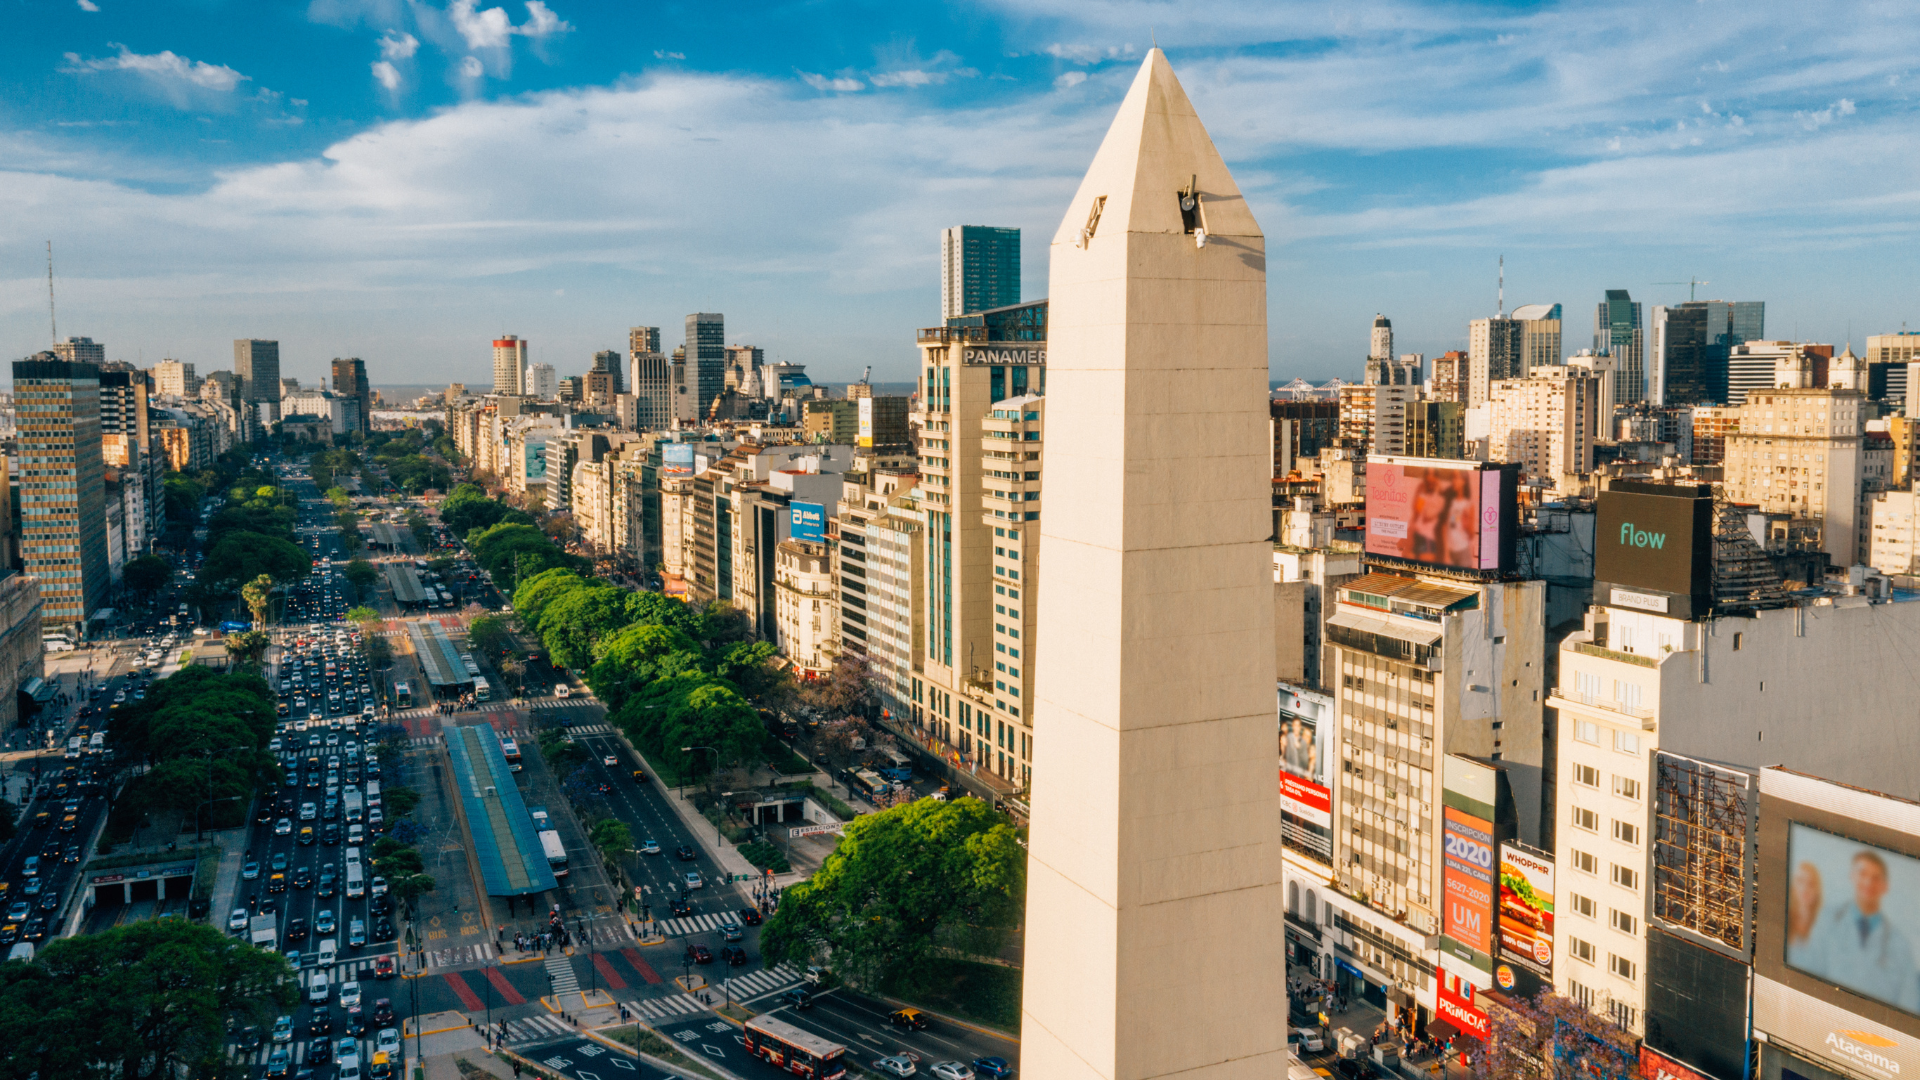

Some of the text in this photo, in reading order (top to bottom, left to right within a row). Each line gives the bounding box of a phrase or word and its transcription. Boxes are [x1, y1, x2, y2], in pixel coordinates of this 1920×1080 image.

[1371, 486, 1408, 503] Teenitas
[1621, 522, 1666, 550] flow
[1618, 593, 1659, 608] BRAND PLUS
[1446, 820, 1490, 843] INSCRIPCIÓN
[1445, 833, 1491, 868] 2020
[1446, 859, 1461, 871] LIMA
[1473, 870, 1490, 883] CABA
[1446, 877, 1490, 904] 5627-2020
[1452, 902, 1481, 934] UM
[1439, 997, 1486, 1032] PRIMICIA
[1825, 1032, 1900, 1074] Atacama
